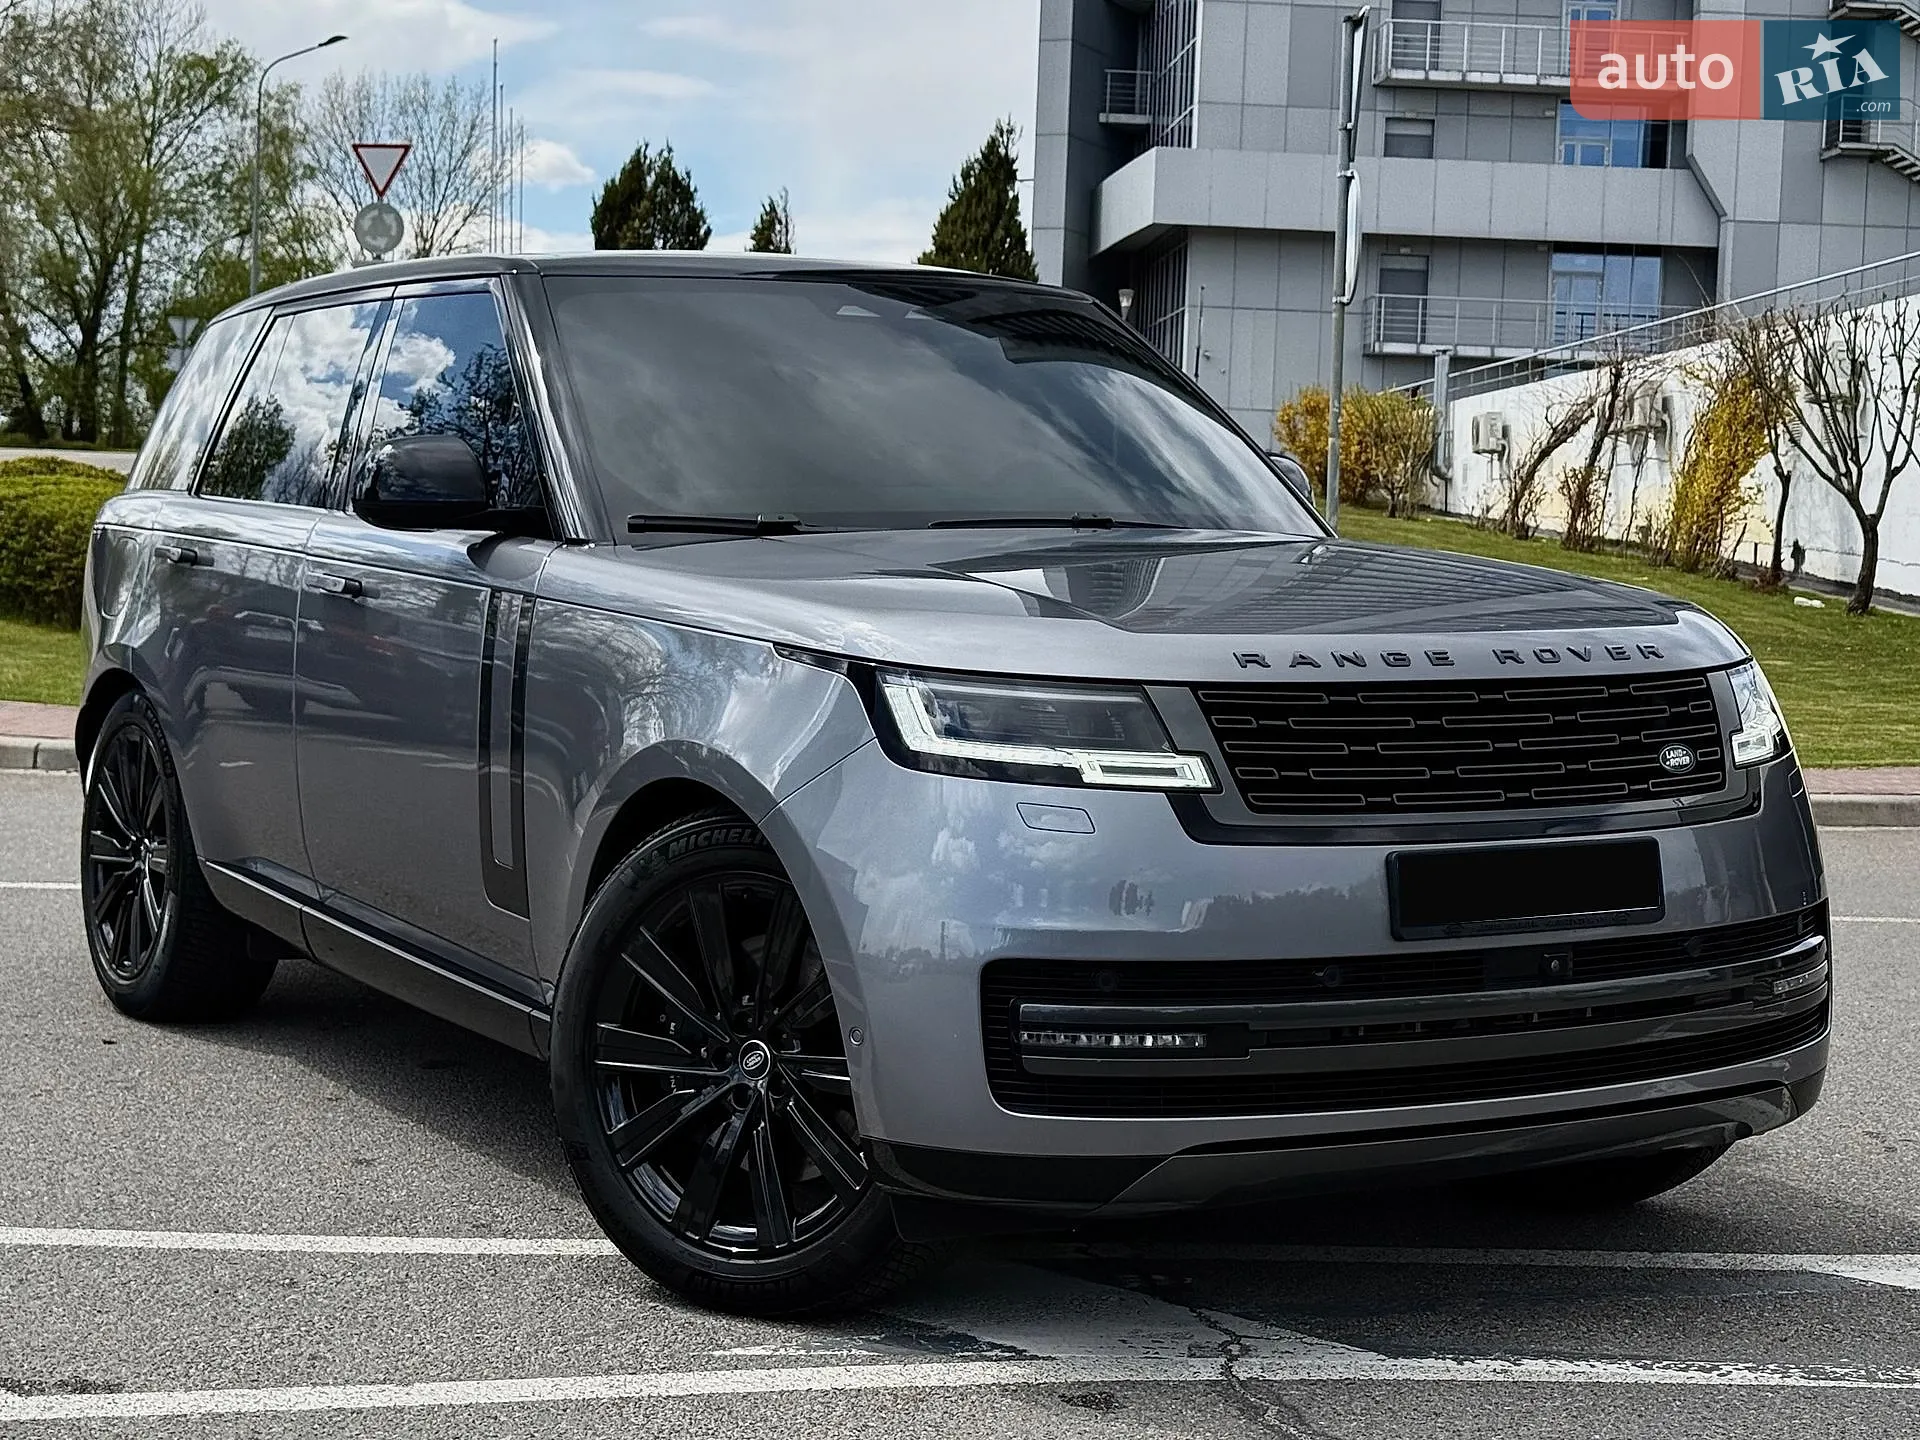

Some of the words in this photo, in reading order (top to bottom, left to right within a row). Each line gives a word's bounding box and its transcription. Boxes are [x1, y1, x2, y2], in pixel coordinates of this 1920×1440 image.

[1232, 650, 1455, 669] RANGE
[1491, 640, 1665, 665] ROVER
[1665, 749, 1683, 759] LAND
[1669, 756, 1690, 767] ROVER
